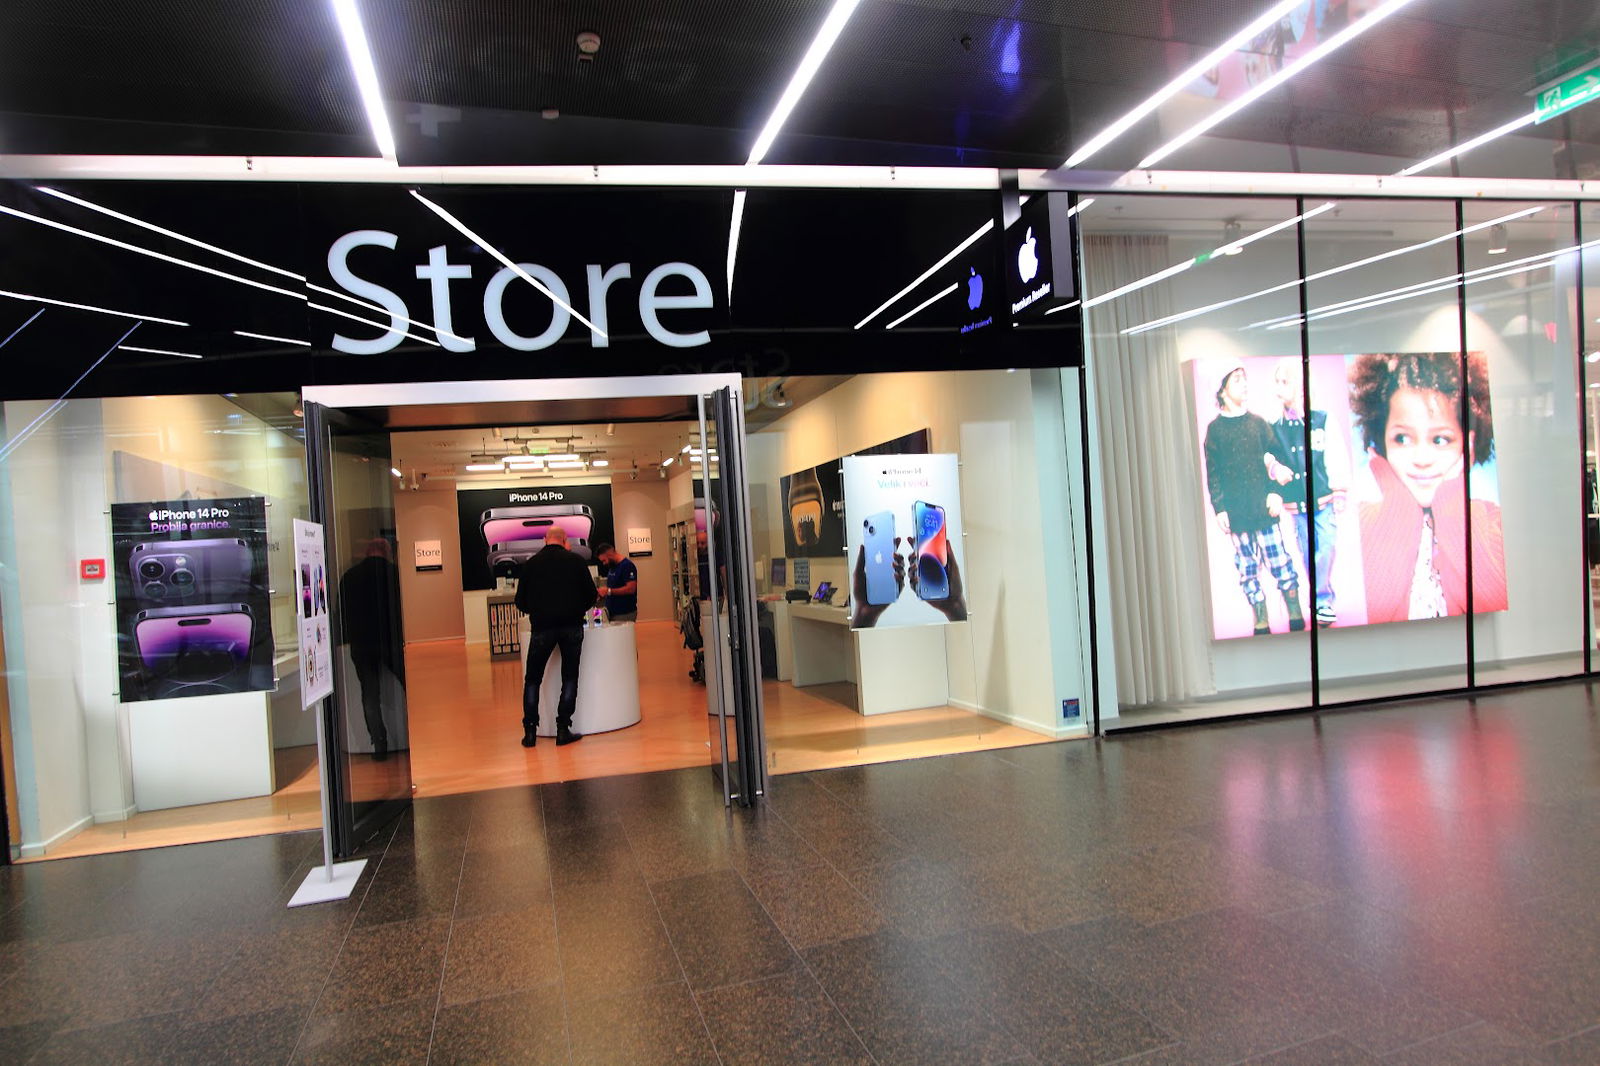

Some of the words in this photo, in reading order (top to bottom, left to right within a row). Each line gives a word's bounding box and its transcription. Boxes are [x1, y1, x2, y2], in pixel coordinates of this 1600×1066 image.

[327, 229, 714, 355] Store
[508, 493, 538, 503] iPhone
[538, 491, 549, 501] 14
[549, 491, 564, 501] Pro
[158, 510, 196, 521] iPhone
[197, 507, 210, 519] 14
[211, 507, 230, 518] Pro
[151, 521, 188, 533] Probija
[629, 536, 651, 545] Store
[416, 548, 441, 558] Store
